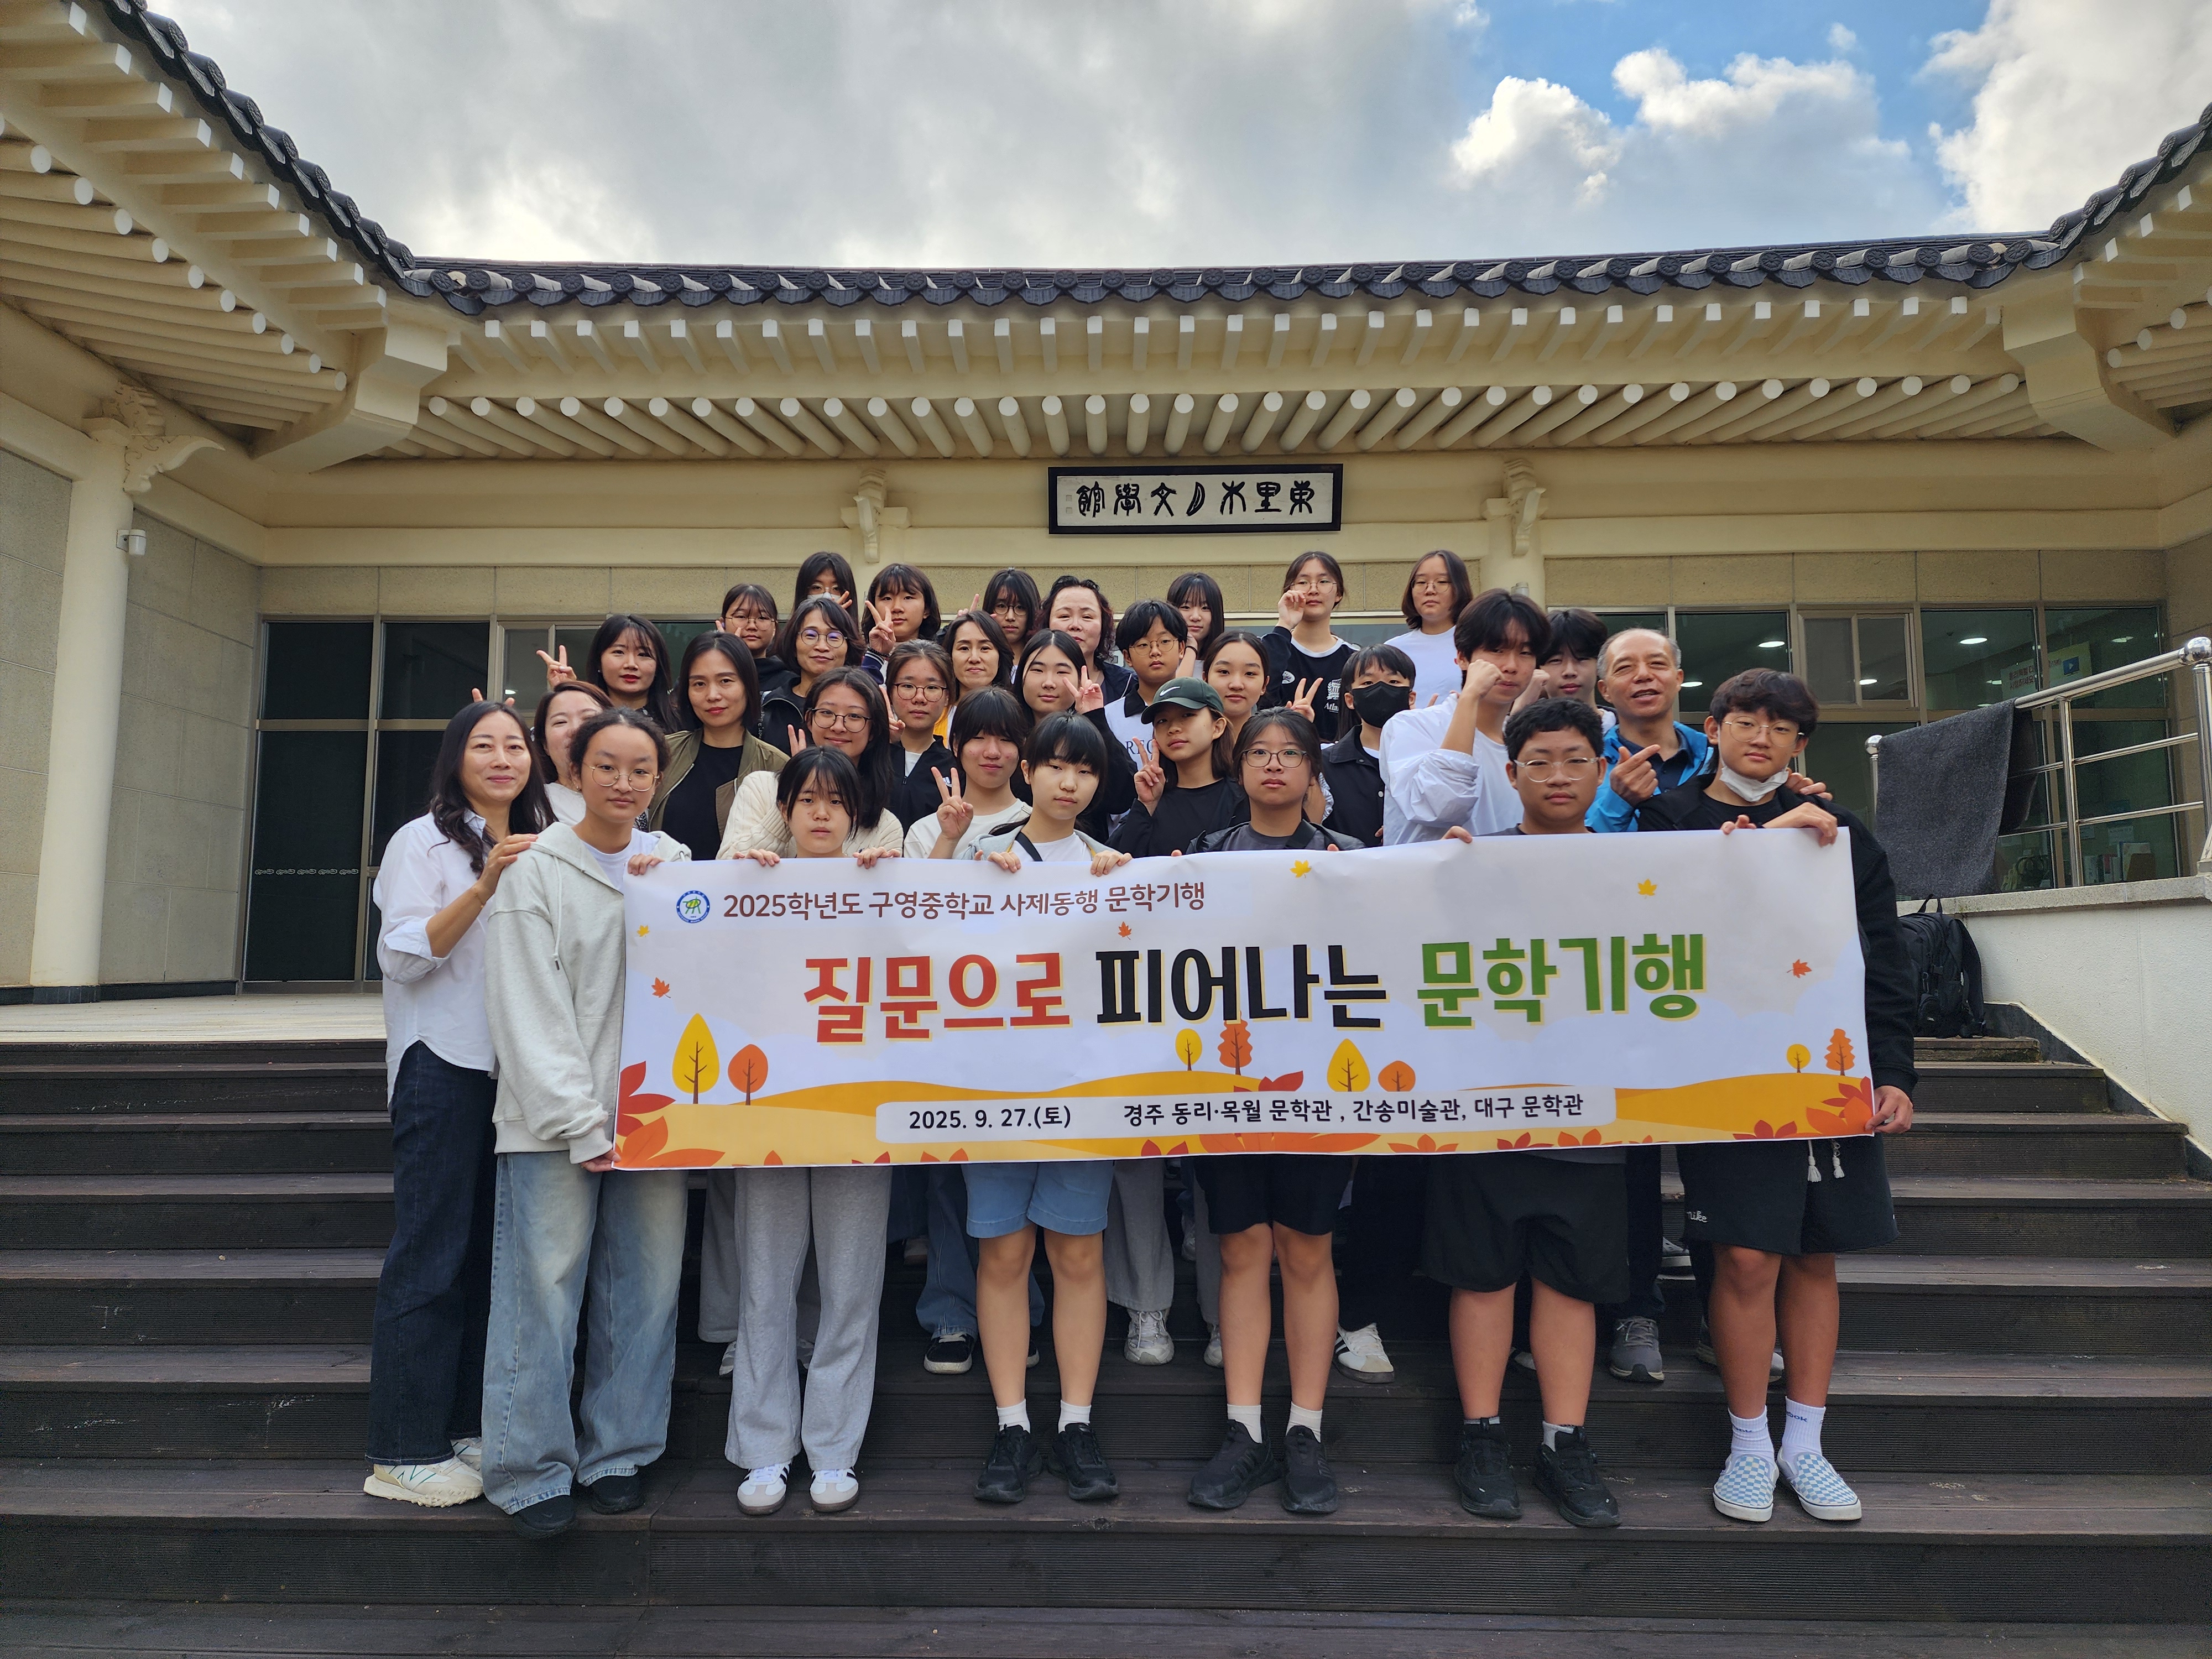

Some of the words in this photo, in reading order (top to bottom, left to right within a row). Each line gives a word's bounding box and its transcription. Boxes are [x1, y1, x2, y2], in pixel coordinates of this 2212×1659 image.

[723, 891, 864, 921] 2025학년도
[868, 891, 994, 920] 구영중학교
[1000, 889, 1098, 917] 사제동행
[1104, 881, 1205, 912] 문학기행
[805, 953, 1071, 1043] 질문으로
[1095, 944, 1386, 1029] 피어나는
[1417, 933, 1703, 1026] 문학기행
[909, 1110, 967, 1129] 2025.
[975, 1109, 993, 1128] 9.
[1001, 1105, 1071, 1129] 27.(토)
[1124, 1104, 1165, 1127] 경주
[1171, 1099, 1262, 1125] 동리·목월
[1353, 1098, 1467, 1123] 간송미술관,
[1474, 1097, 1515, 1119] 대구
[1521, 1093, 1584, 1118] 문학관
